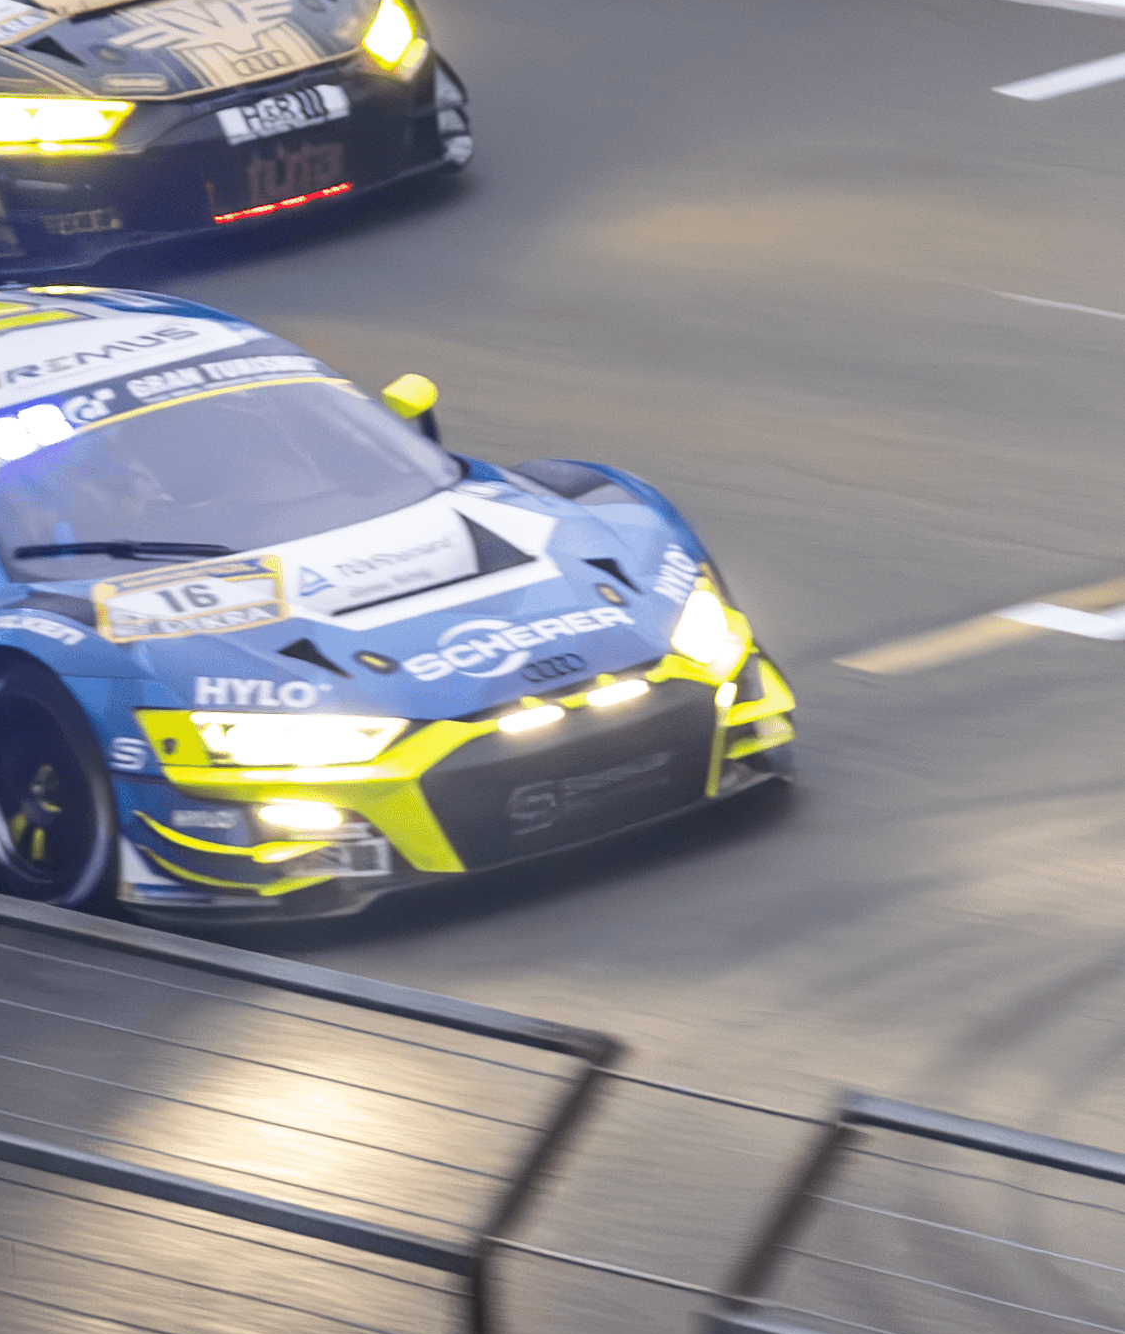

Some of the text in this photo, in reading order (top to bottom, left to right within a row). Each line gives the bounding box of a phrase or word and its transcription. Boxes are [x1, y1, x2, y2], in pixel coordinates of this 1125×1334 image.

[4, 326, 199, 385] REMUS
[125, 366, 206, 398] GRAN
[156, 583, 220, 614] 16
[403, 606, 635, 682] SCHERER
[194, 675, 319, 709] HYLO
